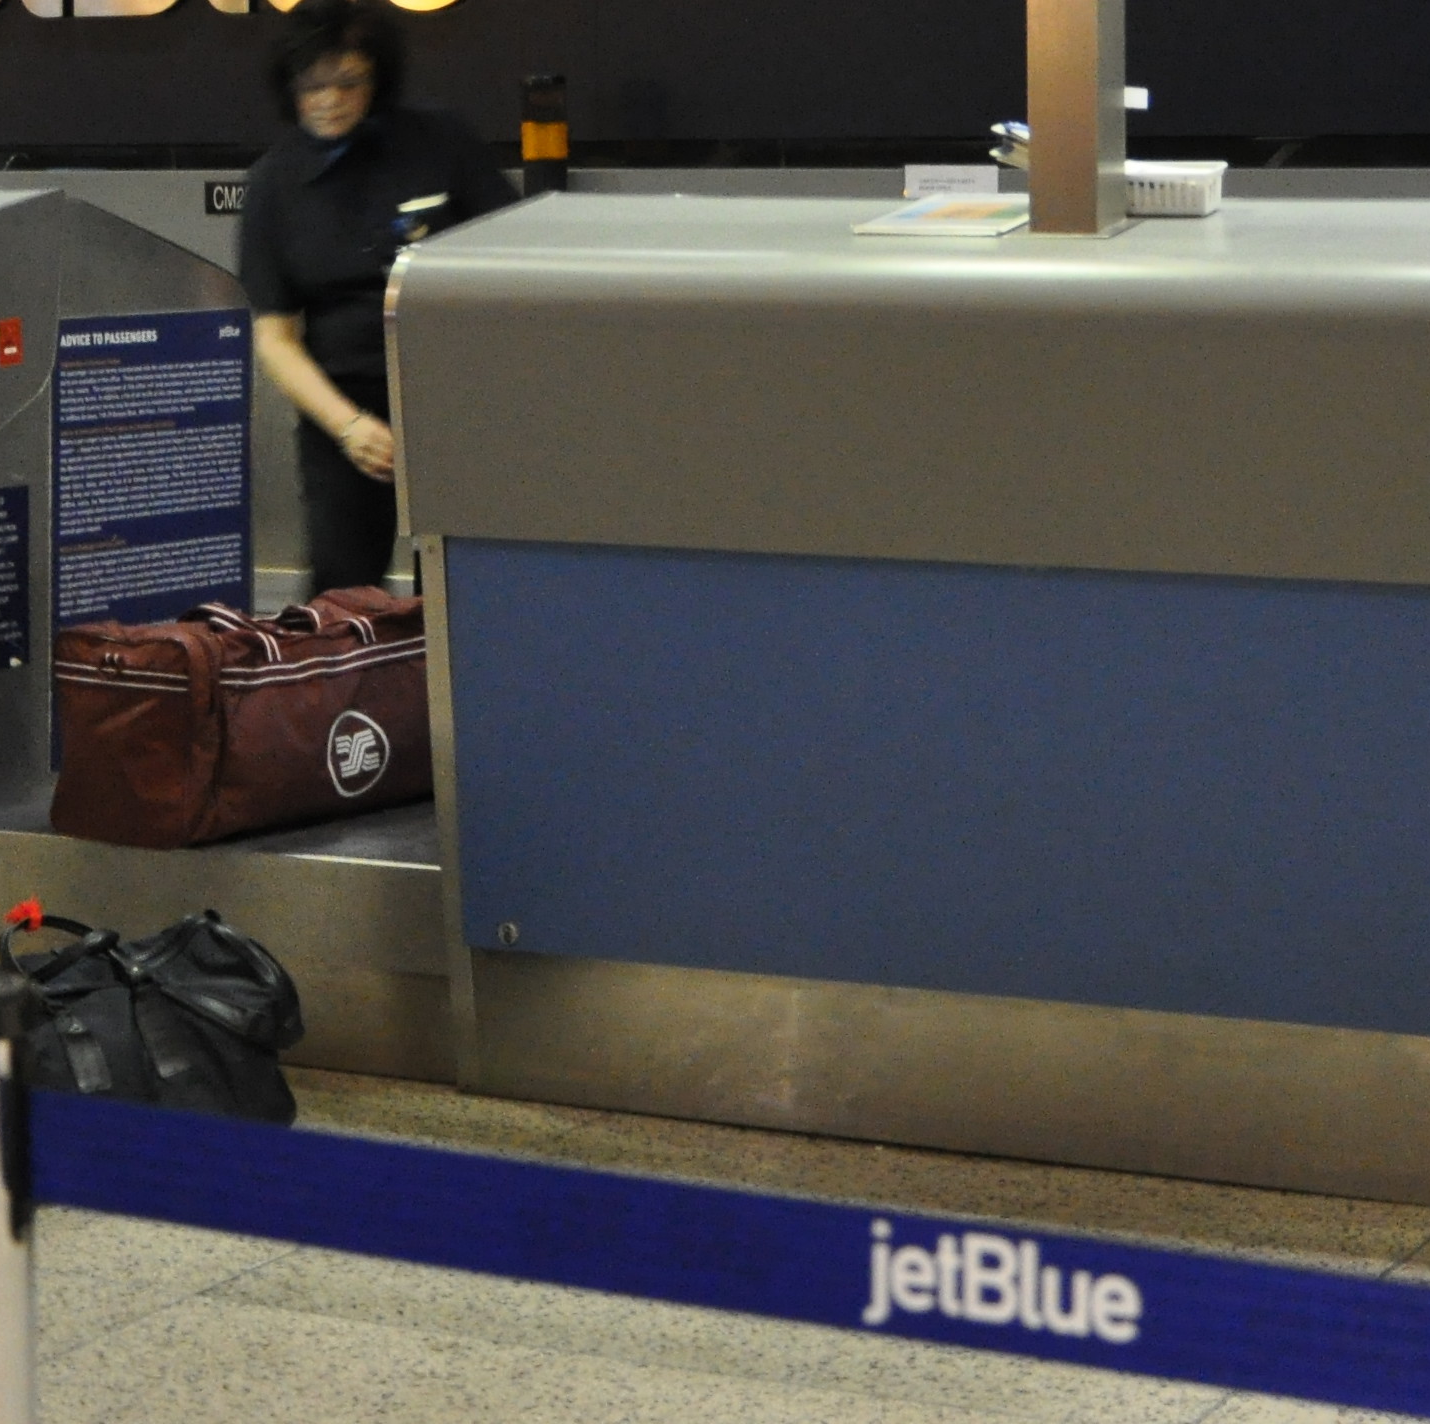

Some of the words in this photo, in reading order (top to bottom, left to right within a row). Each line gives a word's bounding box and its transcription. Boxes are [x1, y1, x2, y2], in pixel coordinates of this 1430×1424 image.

[213, 185, 247, 211] CM2
[60, 333, 92, 348] ADVICE
[93, 333, 104, 346] TO
[105, 329, 158, 345] PASSENGERS
[862, 1218, 1143, 1344] jetBlue
